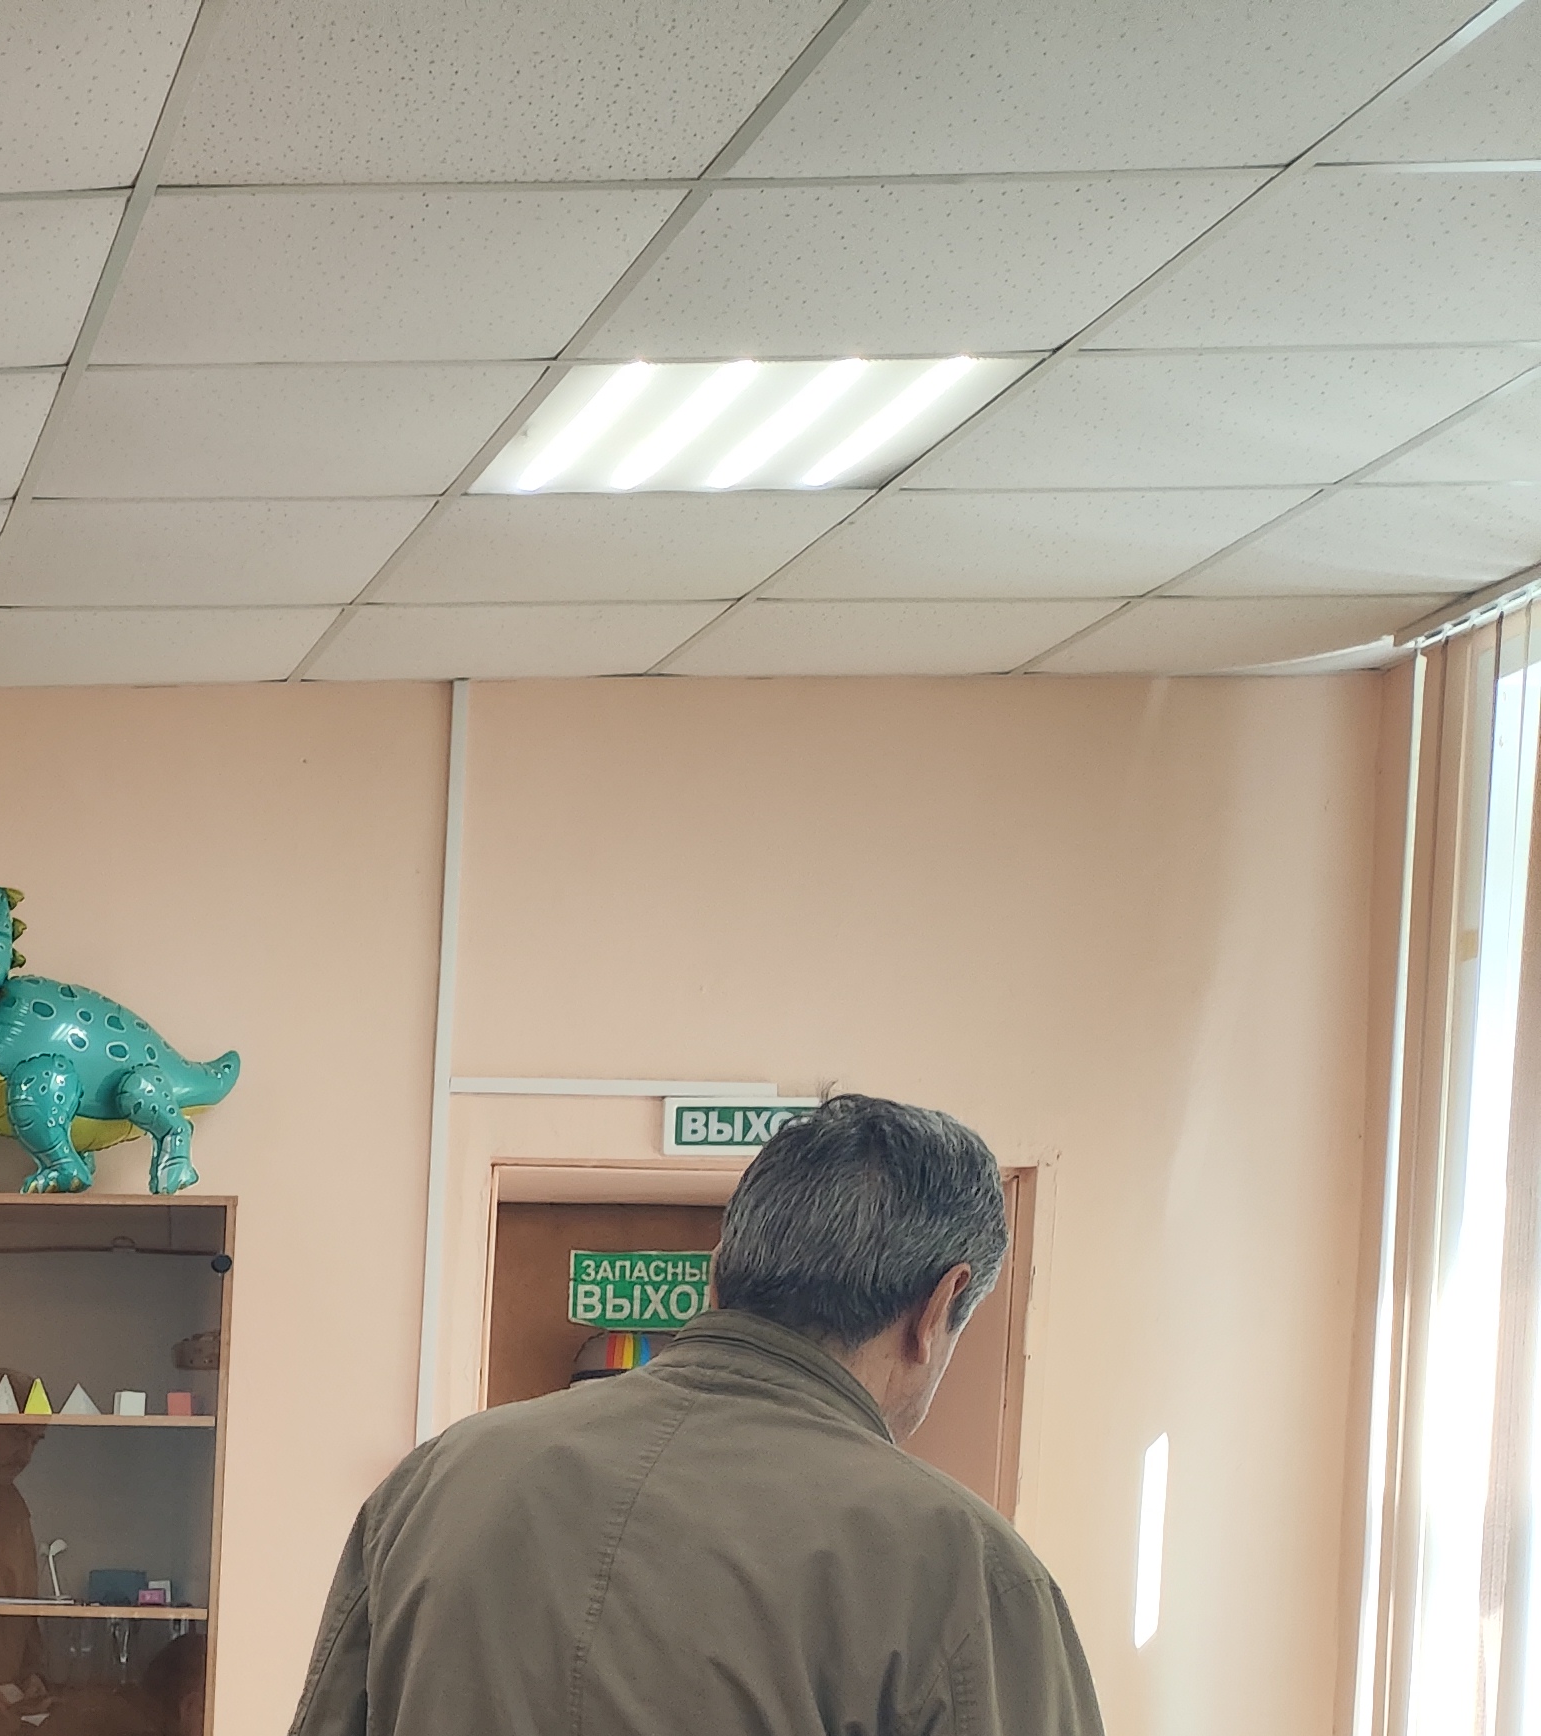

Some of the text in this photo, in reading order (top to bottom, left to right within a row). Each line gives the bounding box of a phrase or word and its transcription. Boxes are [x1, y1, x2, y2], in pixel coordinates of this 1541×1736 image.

[681, 1110, 795, 1143] ВЫХО
[580, 1259, 708, 1282] ЗАПАСНЫ
[576, 1284, 711, 1321] ВЫХО
